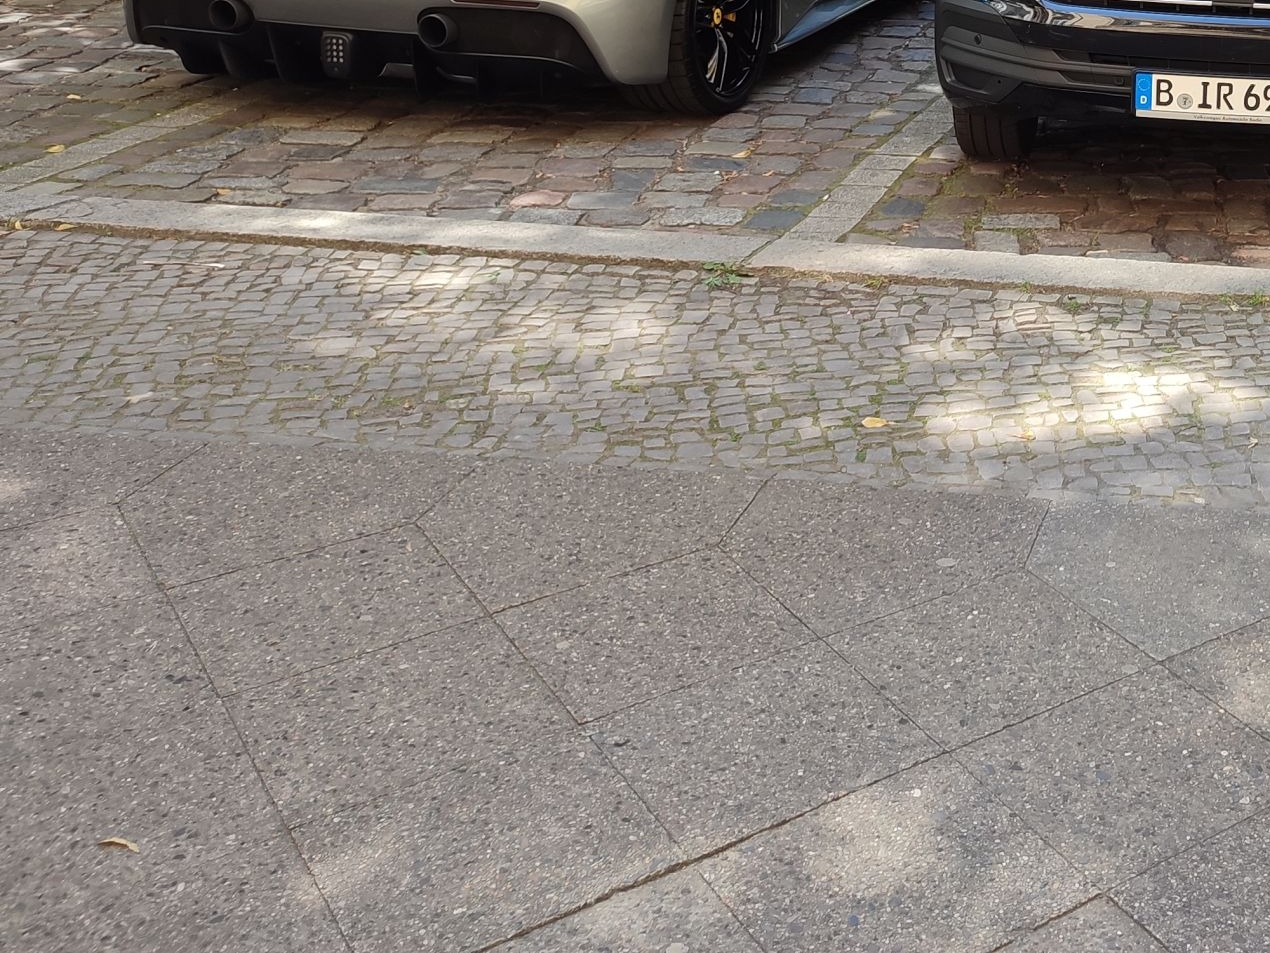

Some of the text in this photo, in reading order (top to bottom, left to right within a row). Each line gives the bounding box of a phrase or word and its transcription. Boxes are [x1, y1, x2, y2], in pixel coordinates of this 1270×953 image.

[1140, 95, 1148, 104] D
[1155, 79, 1174, 106] B
[1197, 81, 1234, 110] IR
